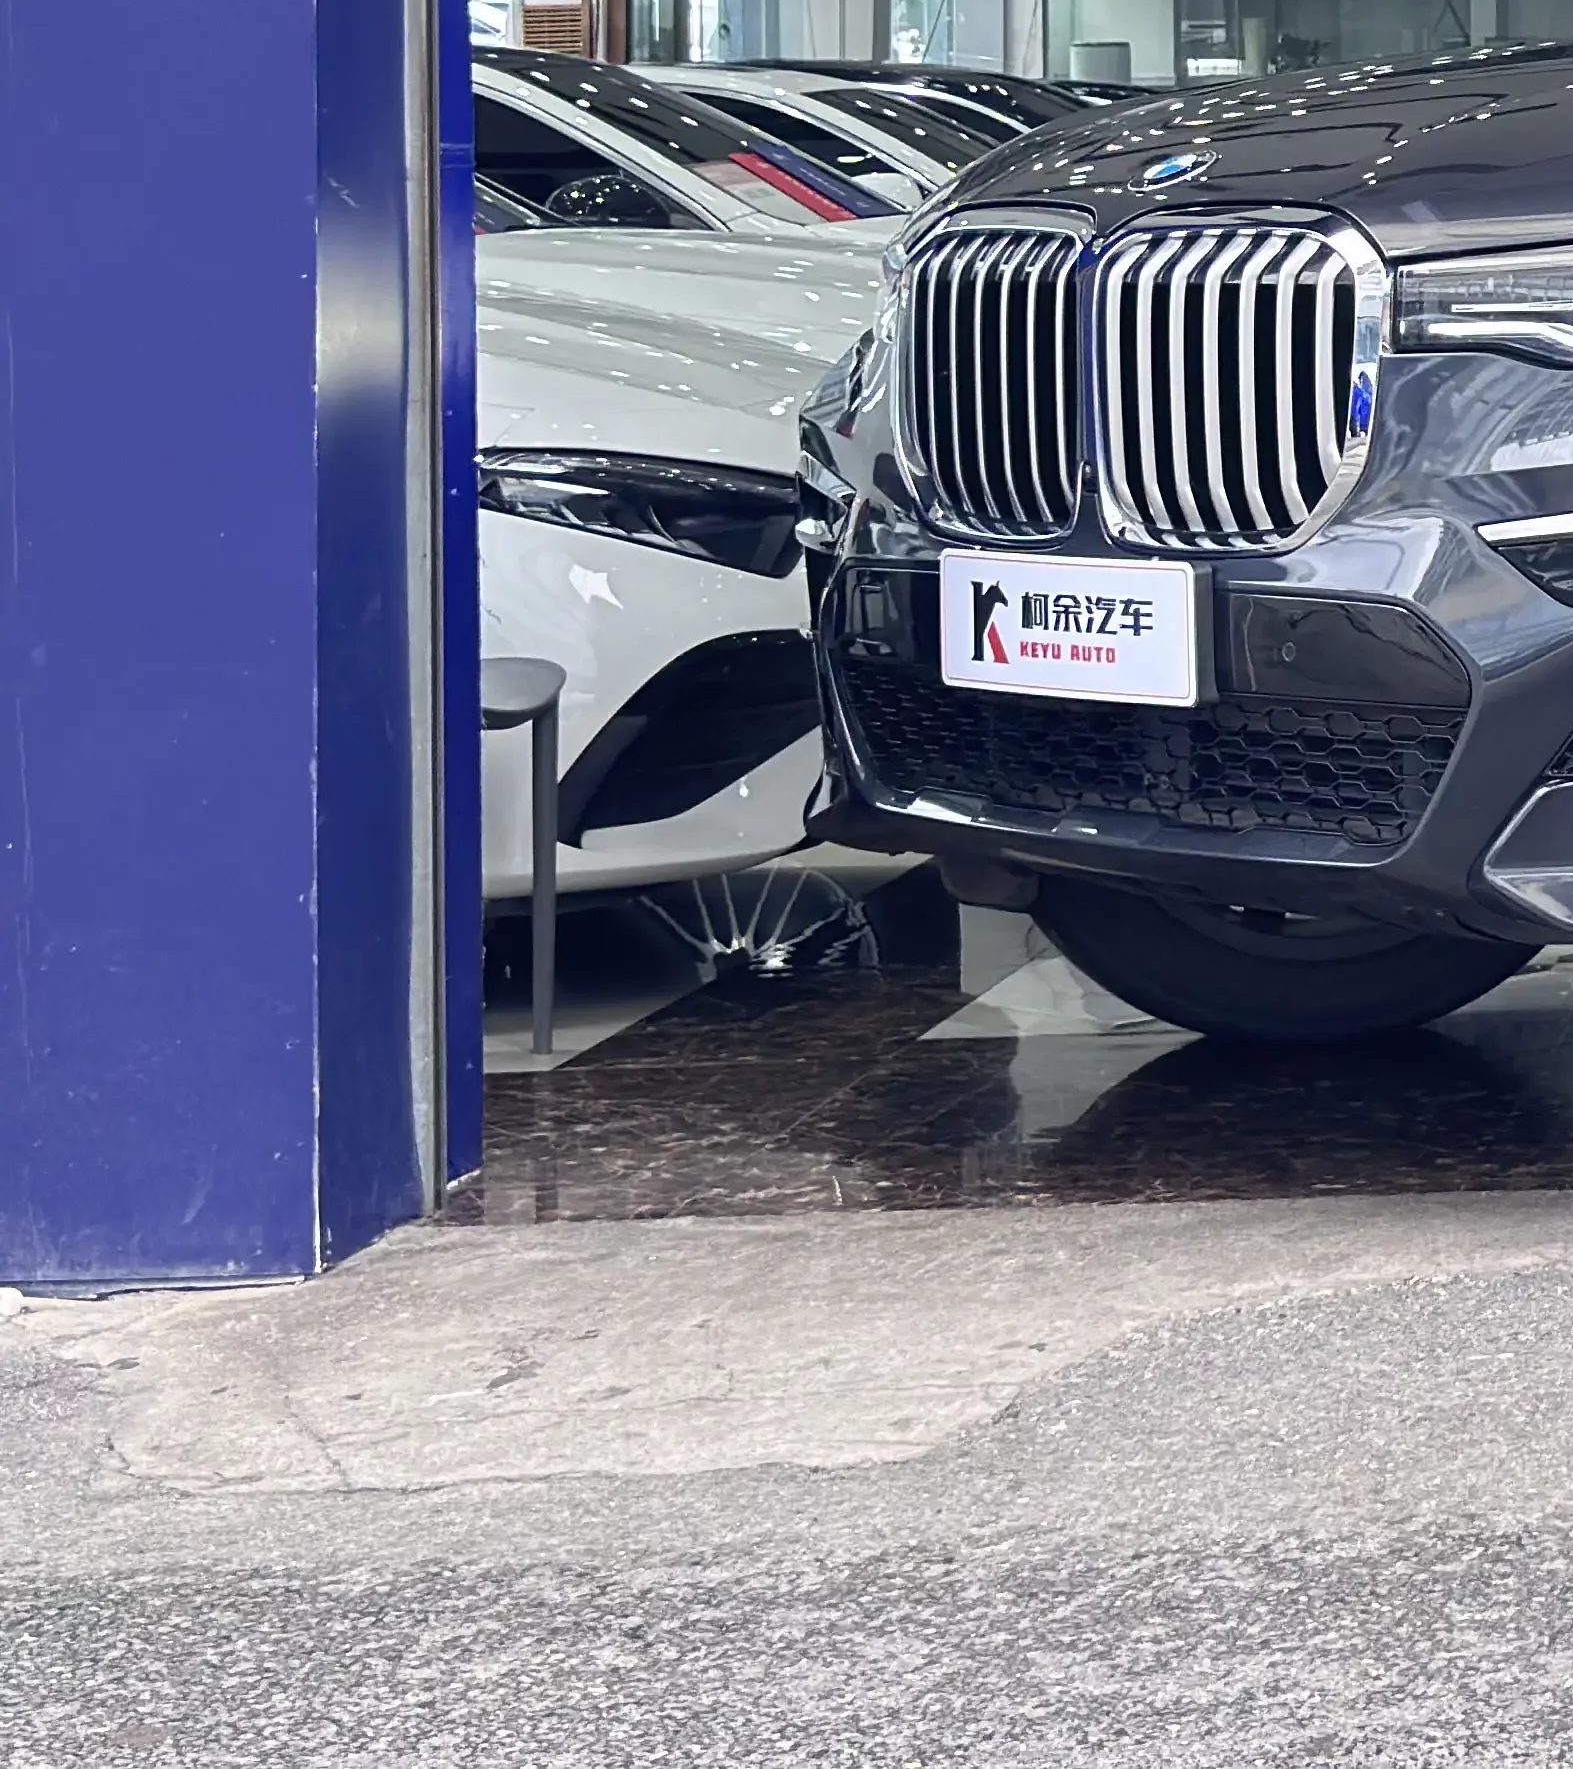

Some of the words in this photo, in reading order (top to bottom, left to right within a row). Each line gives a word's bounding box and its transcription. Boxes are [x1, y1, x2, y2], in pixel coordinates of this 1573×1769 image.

[1021, 591, 1153, 636] 柯余汽车
[1020, 641, 1061, 659] KEYU
[1070, 644, 1116, 663] AUTO
